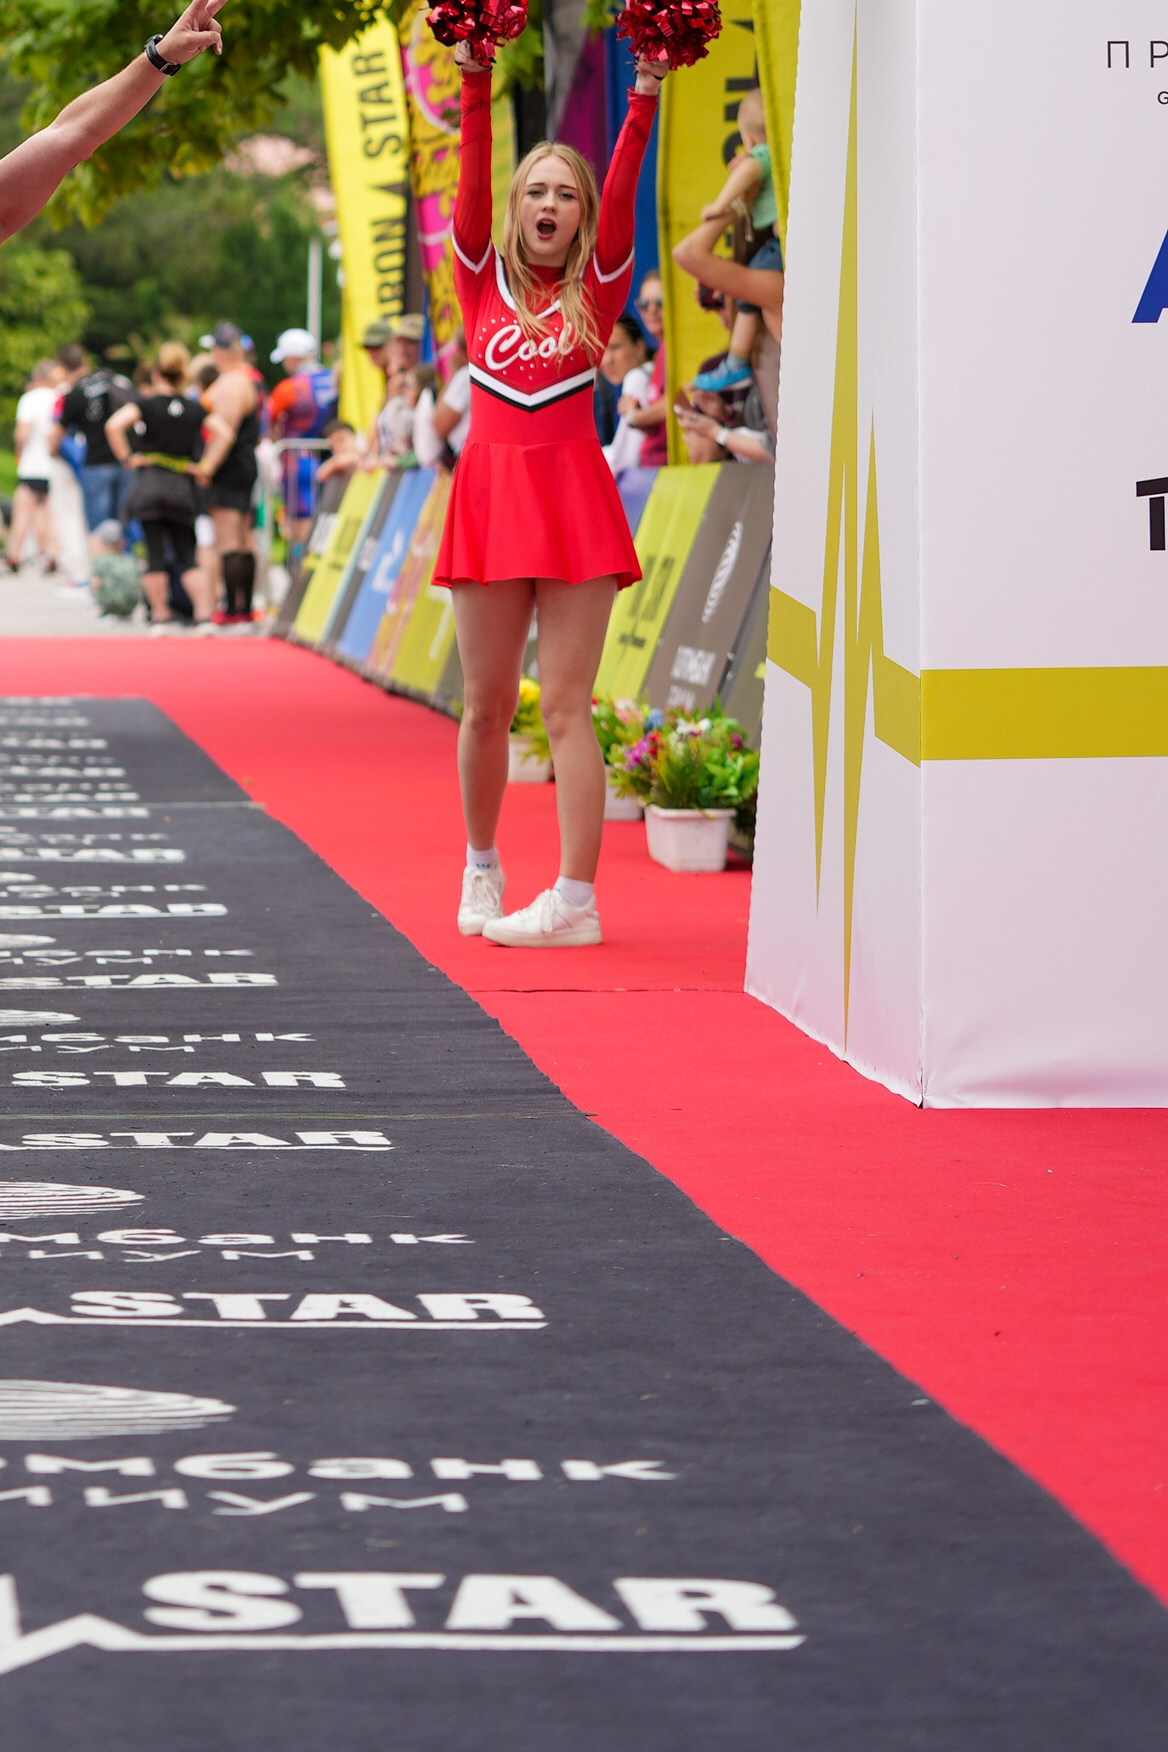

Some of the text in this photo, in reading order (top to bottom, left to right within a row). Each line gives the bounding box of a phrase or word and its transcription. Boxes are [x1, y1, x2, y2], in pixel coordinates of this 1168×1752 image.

[350, 49, 404, 160] STAR
[484, 323, 575, 371] Cool
[11, 1071, 347, 1088] STAR
[21, 1131, 393, 1147] STAR
[69, 1290, 548, 1321] STAR
[141, 1569, 796, 1632] STAR
